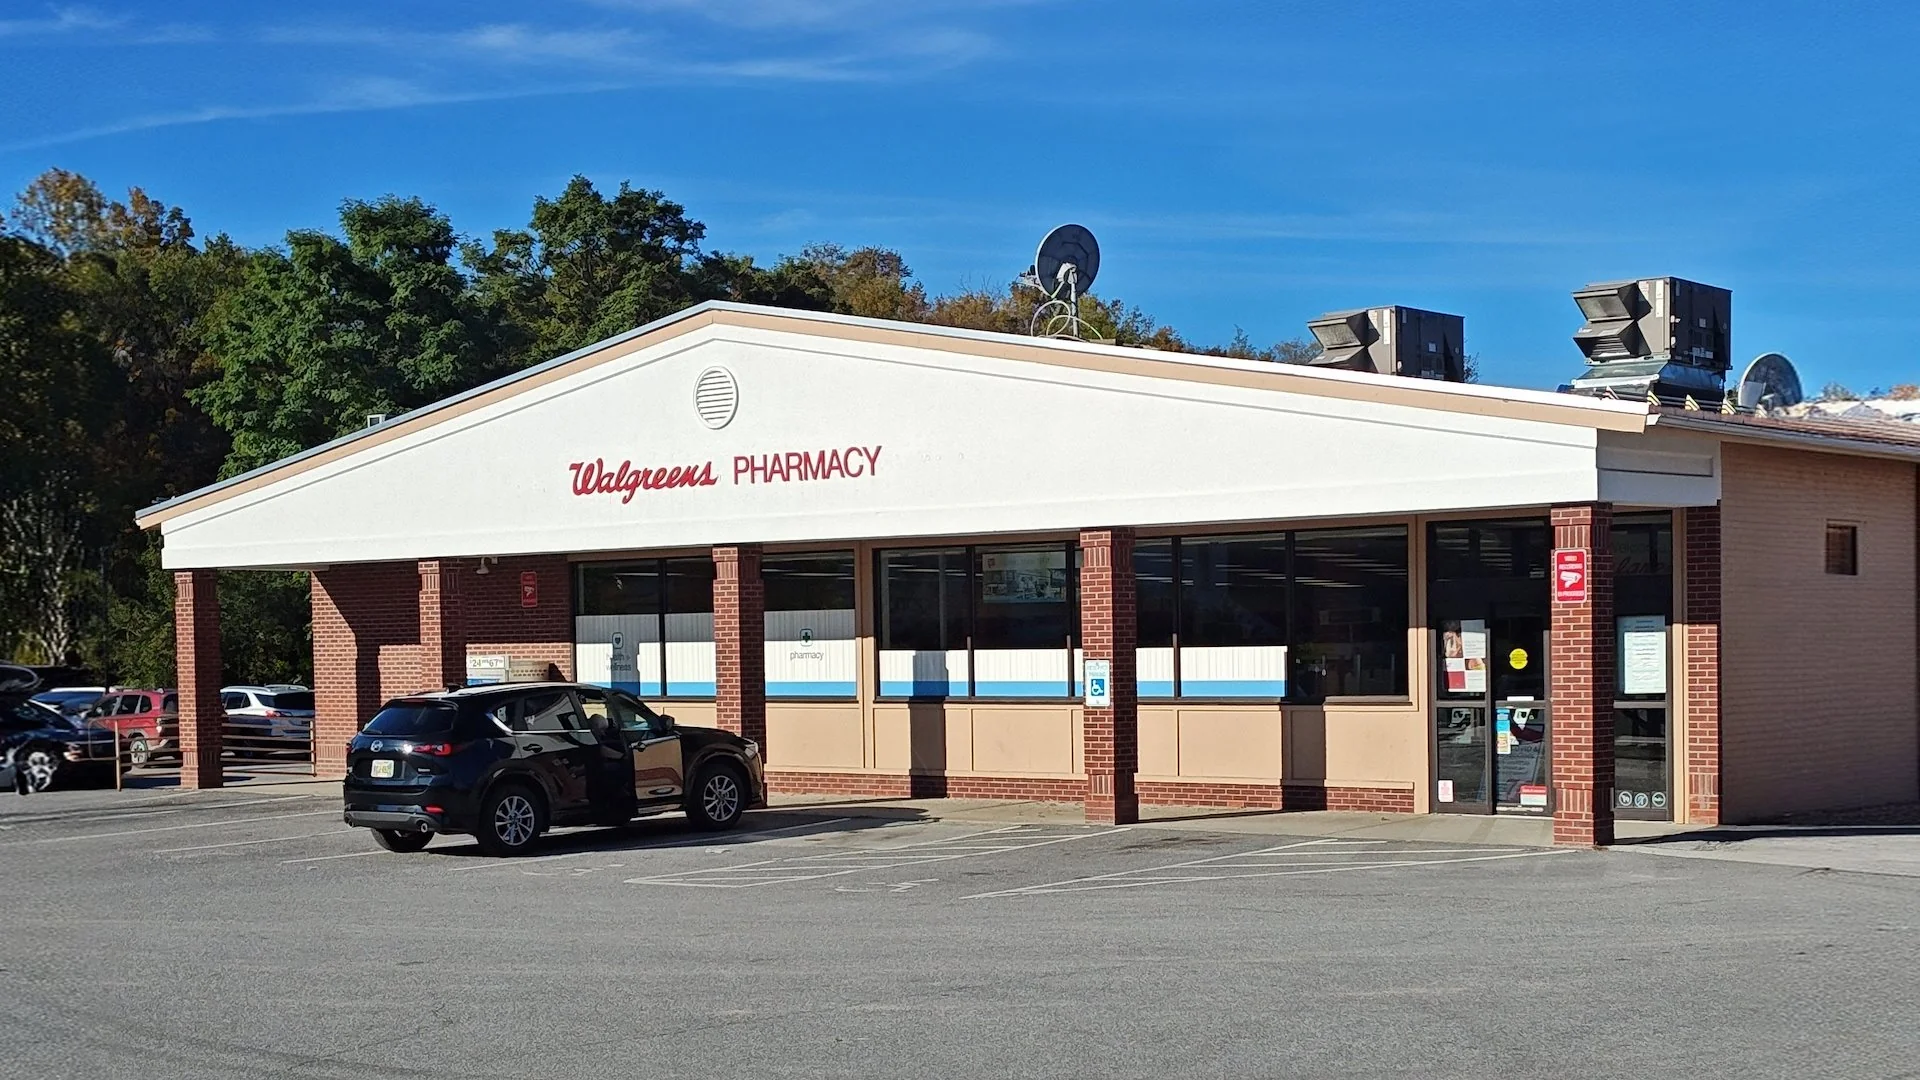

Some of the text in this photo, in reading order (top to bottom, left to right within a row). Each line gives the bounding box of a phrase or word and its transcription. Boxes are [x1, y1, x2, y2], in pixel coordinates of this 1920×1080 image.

[569, 446, 882, 504] Walgreens PHARMACY
[606, 653, 624, 661] halth
[790, 651, 824, 661] pharmacy
